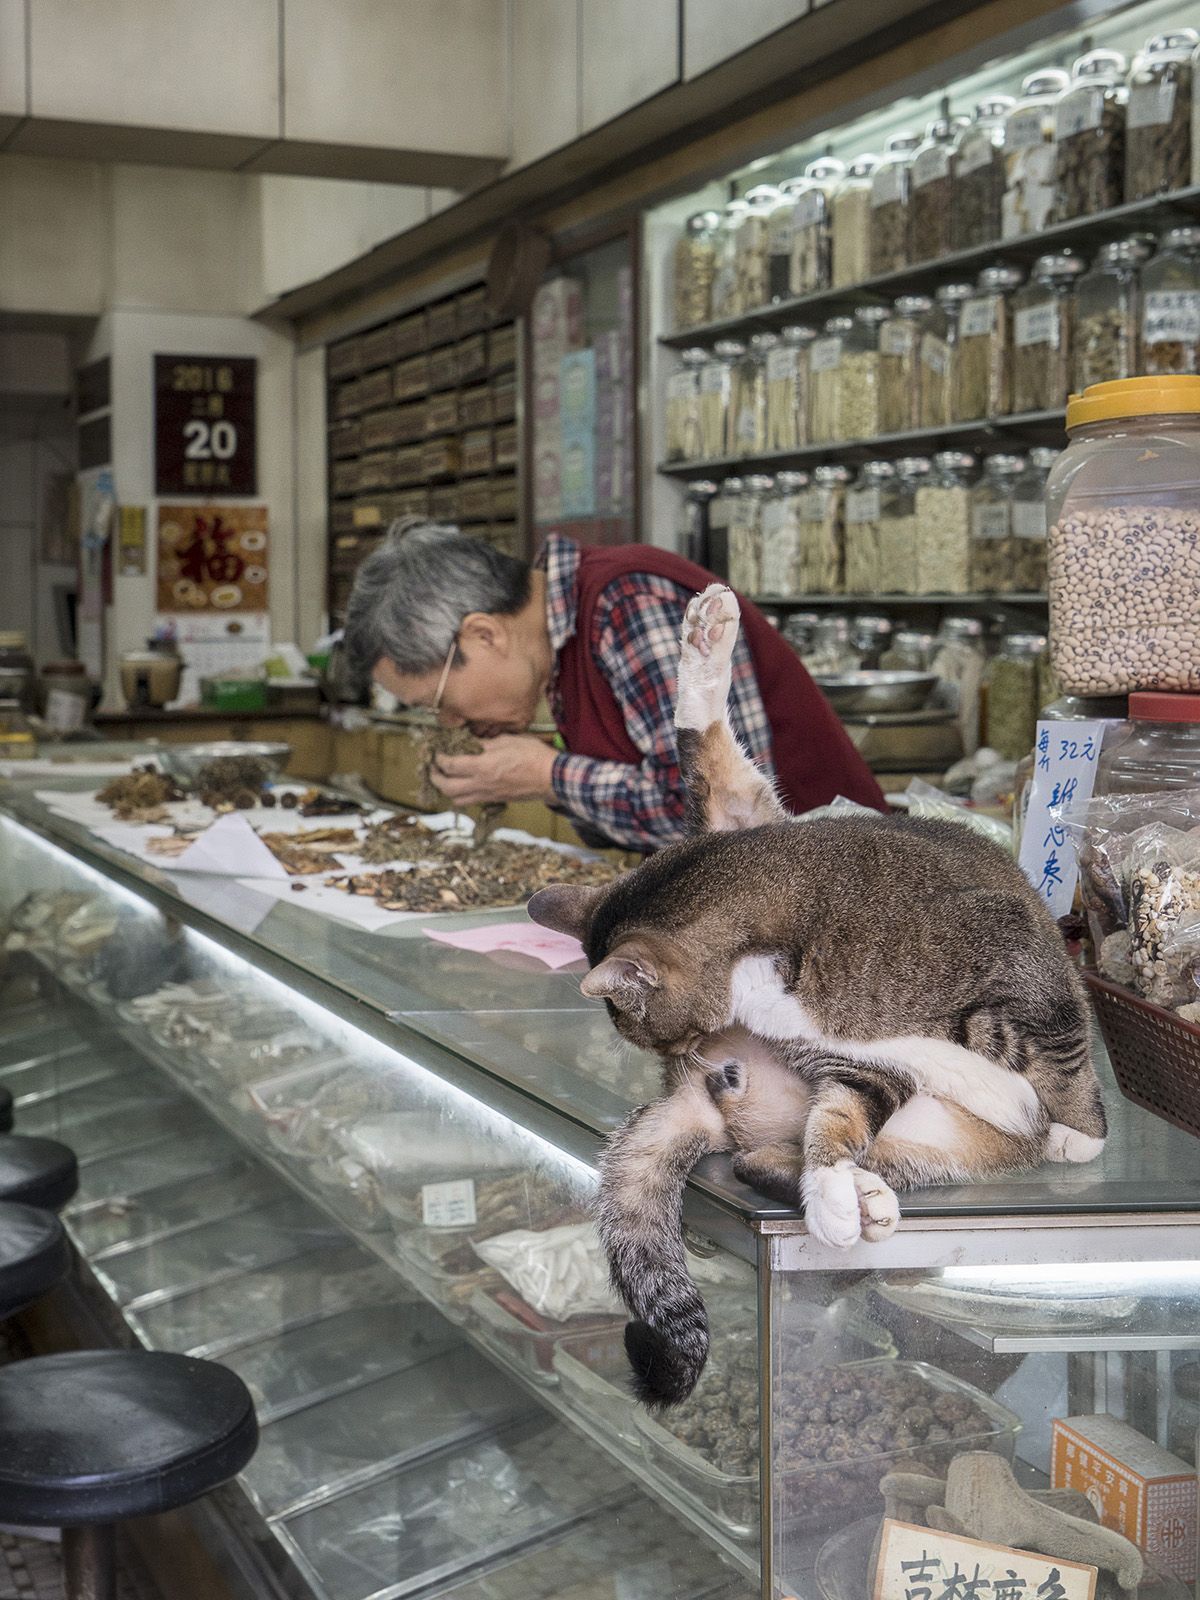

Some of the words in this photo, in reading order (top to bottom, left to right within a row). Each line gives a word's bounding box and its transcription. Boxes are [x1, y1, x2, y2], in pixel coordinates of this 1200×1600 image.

[173, 365, 233, 391] 2016
[183, 420, 237, 459] 20
[1058, 736, 1097, 761] 32元
